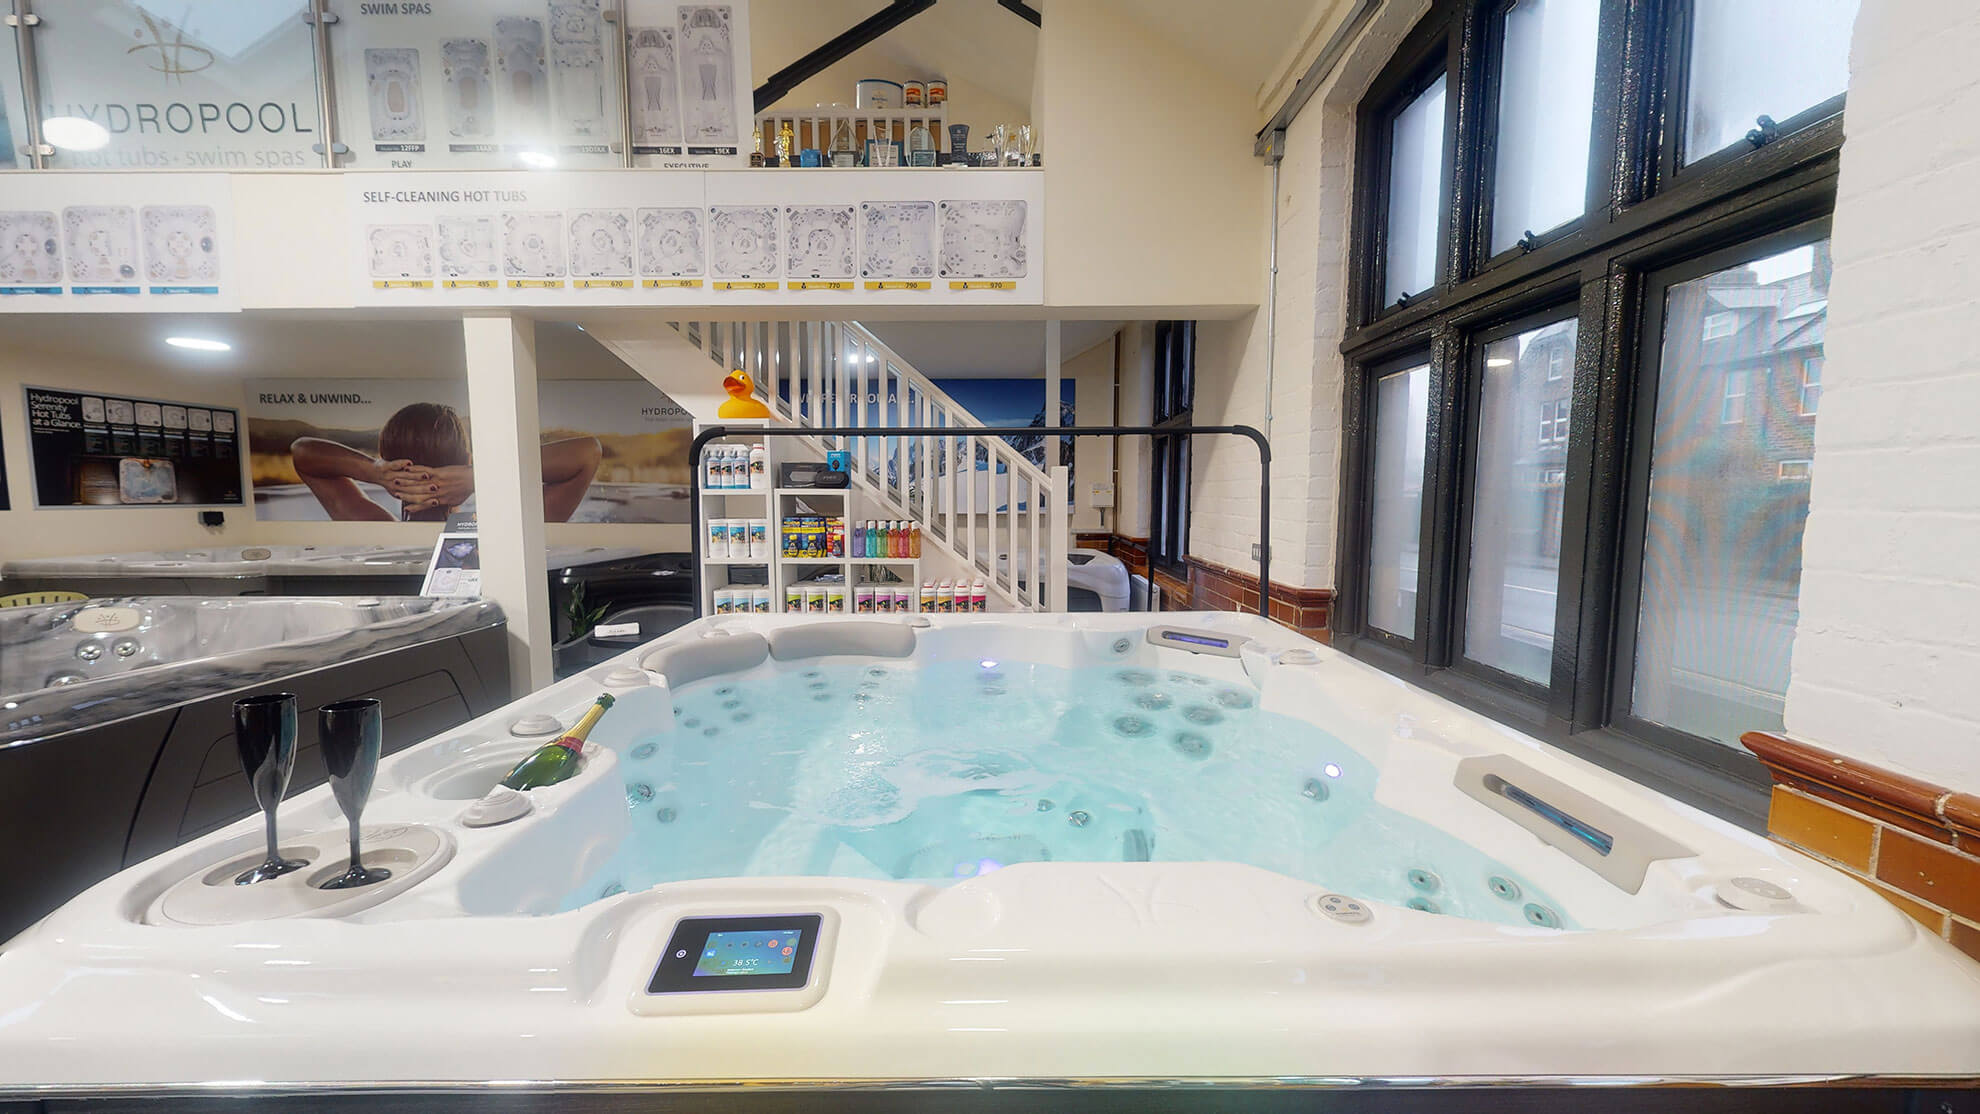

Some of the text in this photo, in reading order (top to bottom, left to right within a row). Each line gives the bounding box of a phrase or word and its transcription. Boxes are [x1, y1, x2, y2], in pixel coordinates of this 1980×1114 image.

[360, 3, 432, 15] SWIM SPAS
[186, 146, 248, 166] swim
[255, 150, 305, 168] spas
[391, 160, 413, 168] PLAY
[363, 190, 528, 202] SELF-CLEANING HOT TUBS
[753, 281, 767, 289] 720
[828, 281, 842, 289] 770
[905, 281, 918, 289] 790
[990, 281, 1003, 289] 970
[30, 392, 79, 405] Hydropool
[259, 393, 295, 404] RELAX
[297, 393, 307, 404] &
[31, 401, 68, 413] Serenity
[641, 407, 688, 416] HYDROPO
[32, 409, 72, 420] Hot Tubs
[32, 418, 42, 426] at
